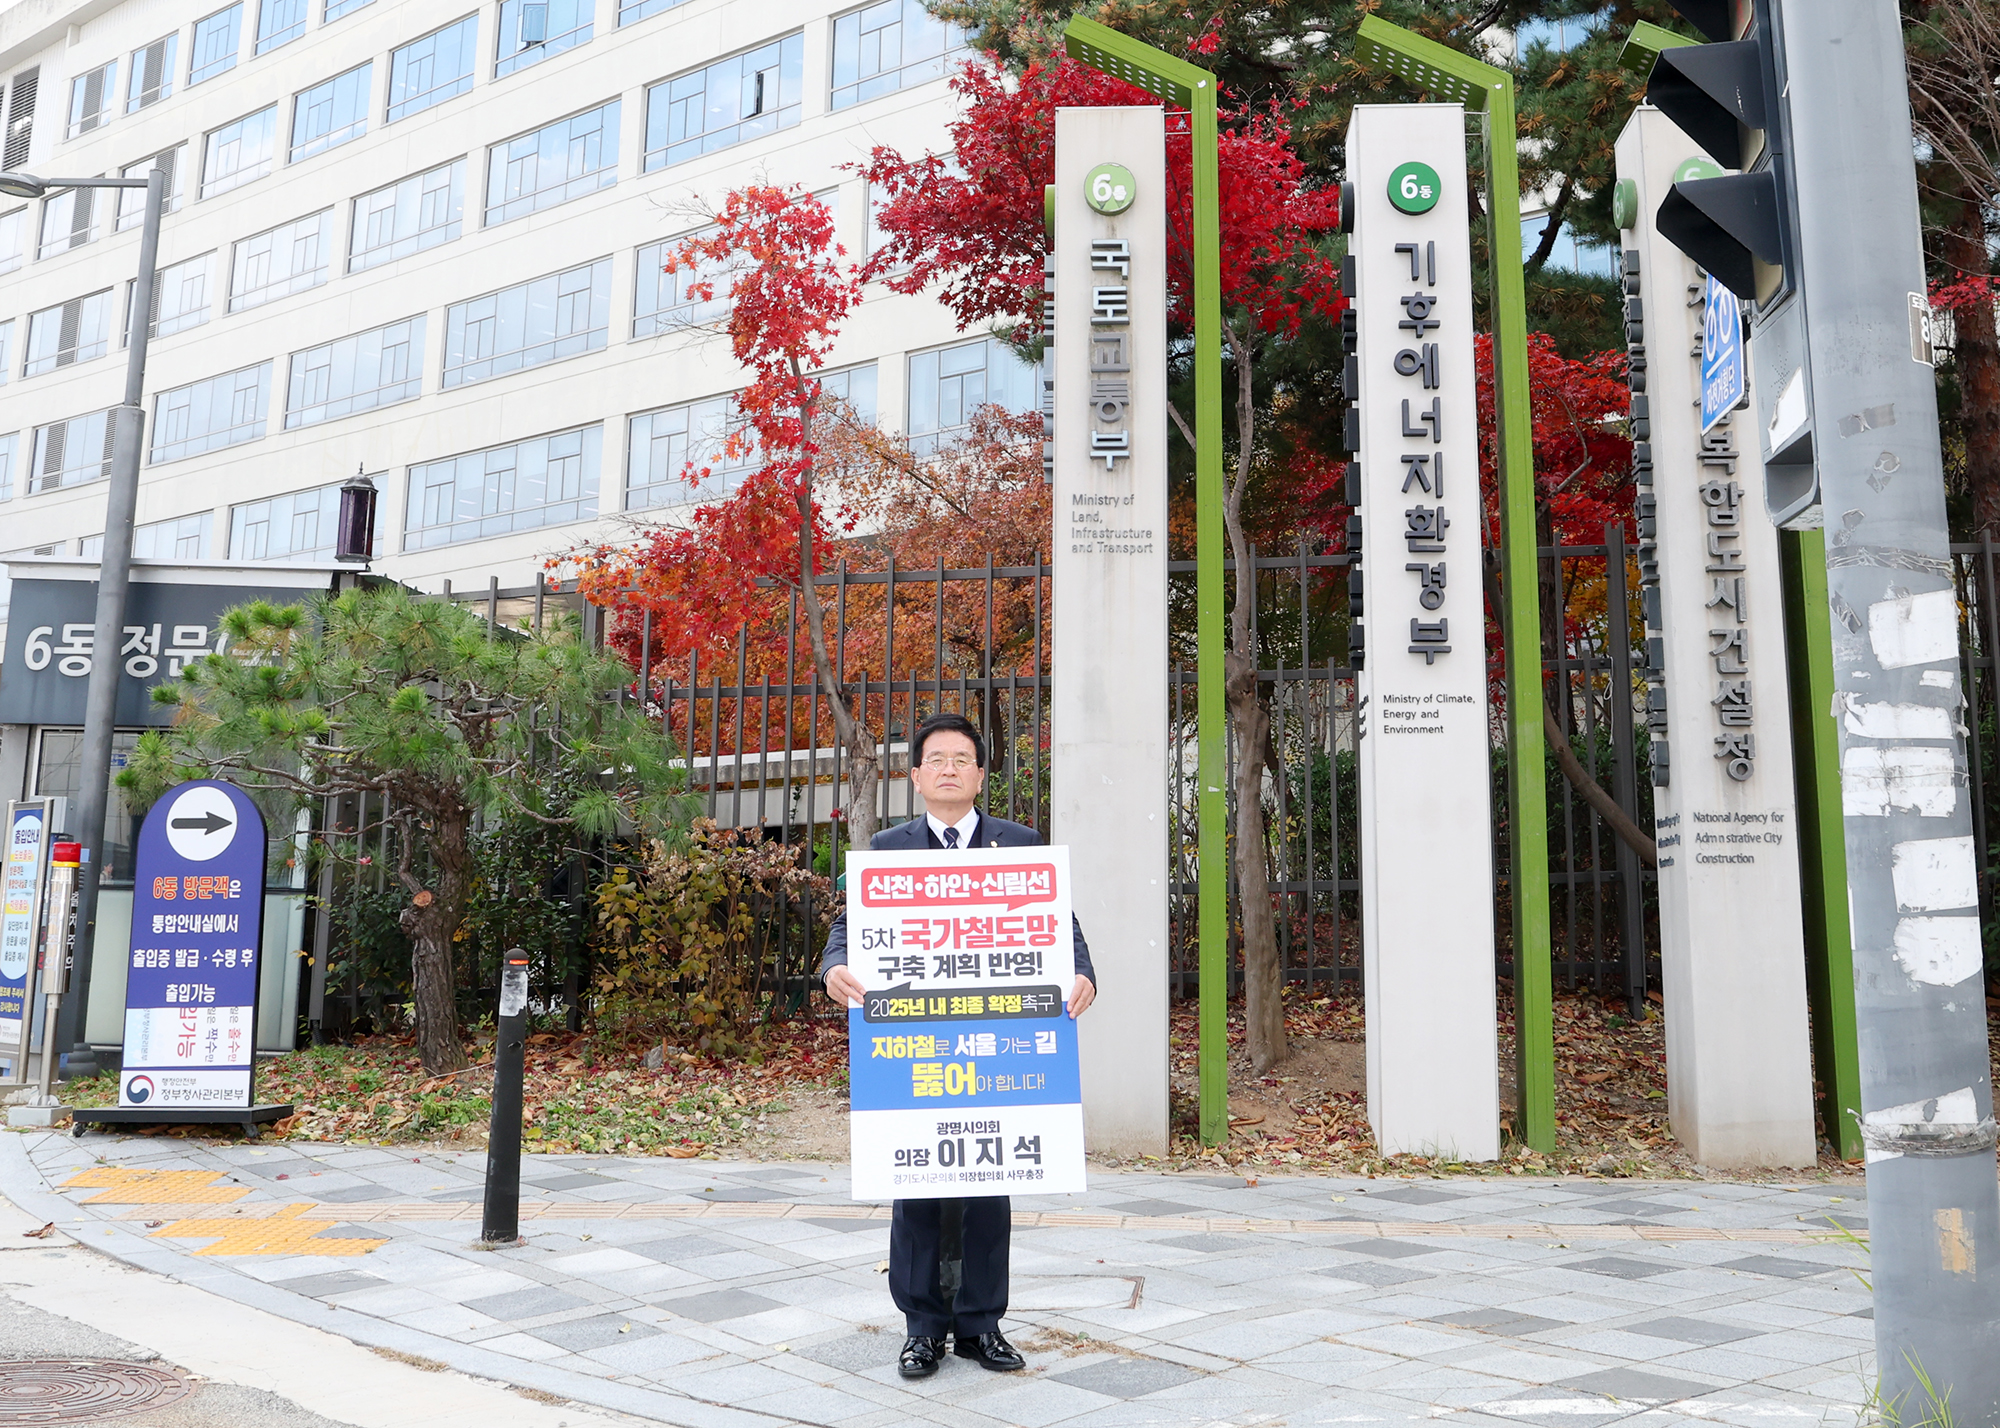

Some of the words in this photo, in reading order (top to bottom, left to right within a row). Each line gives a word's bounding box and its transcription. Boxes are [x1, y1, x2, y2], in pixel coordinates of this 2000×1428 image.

[1092, 173, 1127, 202] 6동
[1400, 173, 1433, 199] 6동
[1090, 238, 1130, 471] 국토교통부
[1394, 240, 1451, 665] 기후에너지환경부
[1072, 493, 1120, 508] Ministry
[1123, 493, 1134, 505] of
[1071, 510, 1103, 524] Land,
[1071, 527, 1153, 539] Infrastructure
[1071, 541, 1093, 554] and
[1097, 541, 1153, 555] Transport
[24, 623, 98, 677] 6동
[1383, 694, 1420, 705] Ministry
[1423, 693, 1433, 704] of
[1436, 693, 1476, 704] Climate,
[1383, 709, 1417, 720] Energy
[1421, 709, 1440, 719] and
[1383, 724, 1444, 734] Environment
[1693, 811, 1731, 823] National
[1733, 812, 1768, 825] Agency
[1771, 811, 1784, 823] for
[1763, 832, 1783, 845] City
[1695, 852, 1755, 864] Construction
[152, 876, 179, 901] 6동
[183, 875, 241, 901] 방문객은
[867, 870, 1051, 900] 신천·하안·신림선
[151, 914, 239, 934] 통합안내실에서
[861, 927, 896, 950] 5차
[901, 914, 1059, 950] 국가철도망
[132, 948, 171, 968] 출입증
[174, 948, 200, 968] 발급
[211, 948, 237, 968] 수령
[240, 948, 254, 968] 후
[878, 954, 926, 981] 구축
[933, 952, 981, 979] 계획
[988, 951, 1043, 978] 반영!
[165, 983, 216, 1003] 출입가능
[870, 997, 926, 1018] 2025년
[929, 996, 947, 1015] 내
[950, 995, 985, 1015] 최종
[988, 993, 1055, 1014] 확정촉구
[871, 1034, 950, 1059] 지하철로
[954, 1032, 998, 1057] 서울
[1000, 1036, 1031, 1055] 가는
[1034, 1030, 1058, 1055] 길
[911, 1061, 993, 1097] 뚫어야
[995, 1072, 1046, 1092] 합니다!
[161, 1088, 244, 1101] 정부청사관리본부
[936, 1120, 1001, 1135] 광명시의회
[894, 1148, 931, 1168] 의장
[893, 1172, 957, 1185] 경기도시군의회
[958, 1170, 1004, 1182] 의장협의회
[1006, 1168, 1044, 1181] 사무총장
